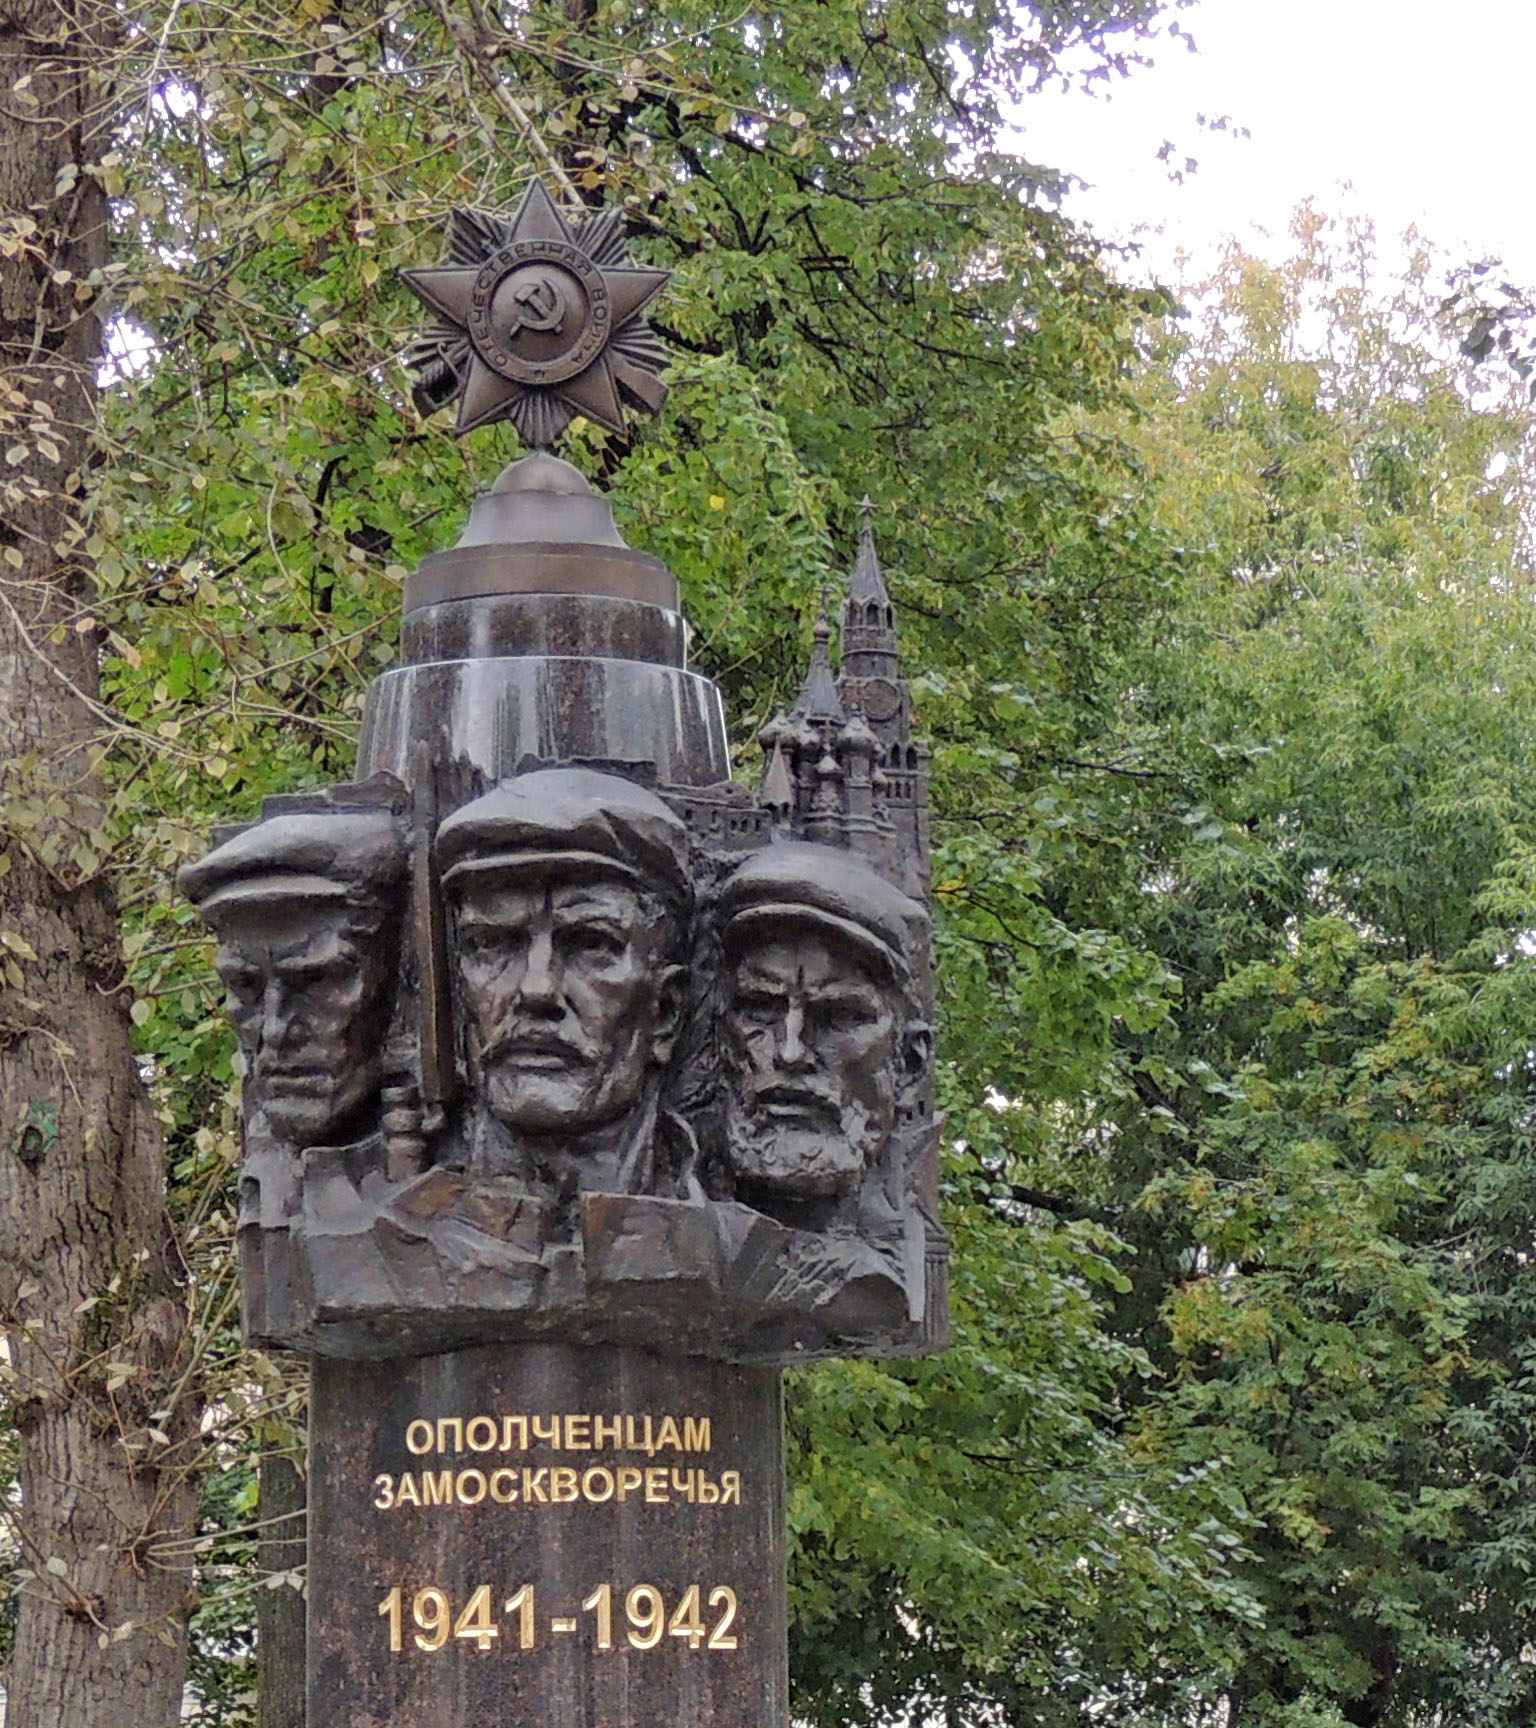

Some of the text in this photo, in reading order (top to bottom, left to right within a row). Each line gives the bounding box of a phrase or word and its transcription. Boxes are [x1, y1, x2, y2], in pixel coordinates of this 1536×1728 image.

[472, 240, 607, 367] ОТЕЧЕСТВЕННАЯ ВОЙНА
[406, 1415, 712, 1457] ОПОЛЧЕНЦАМ
[374, 1466, 741, 1509] ЗАМОСКВОРЕЧЬЯ
[378, 1583, 739, 1652] 1941-1942
